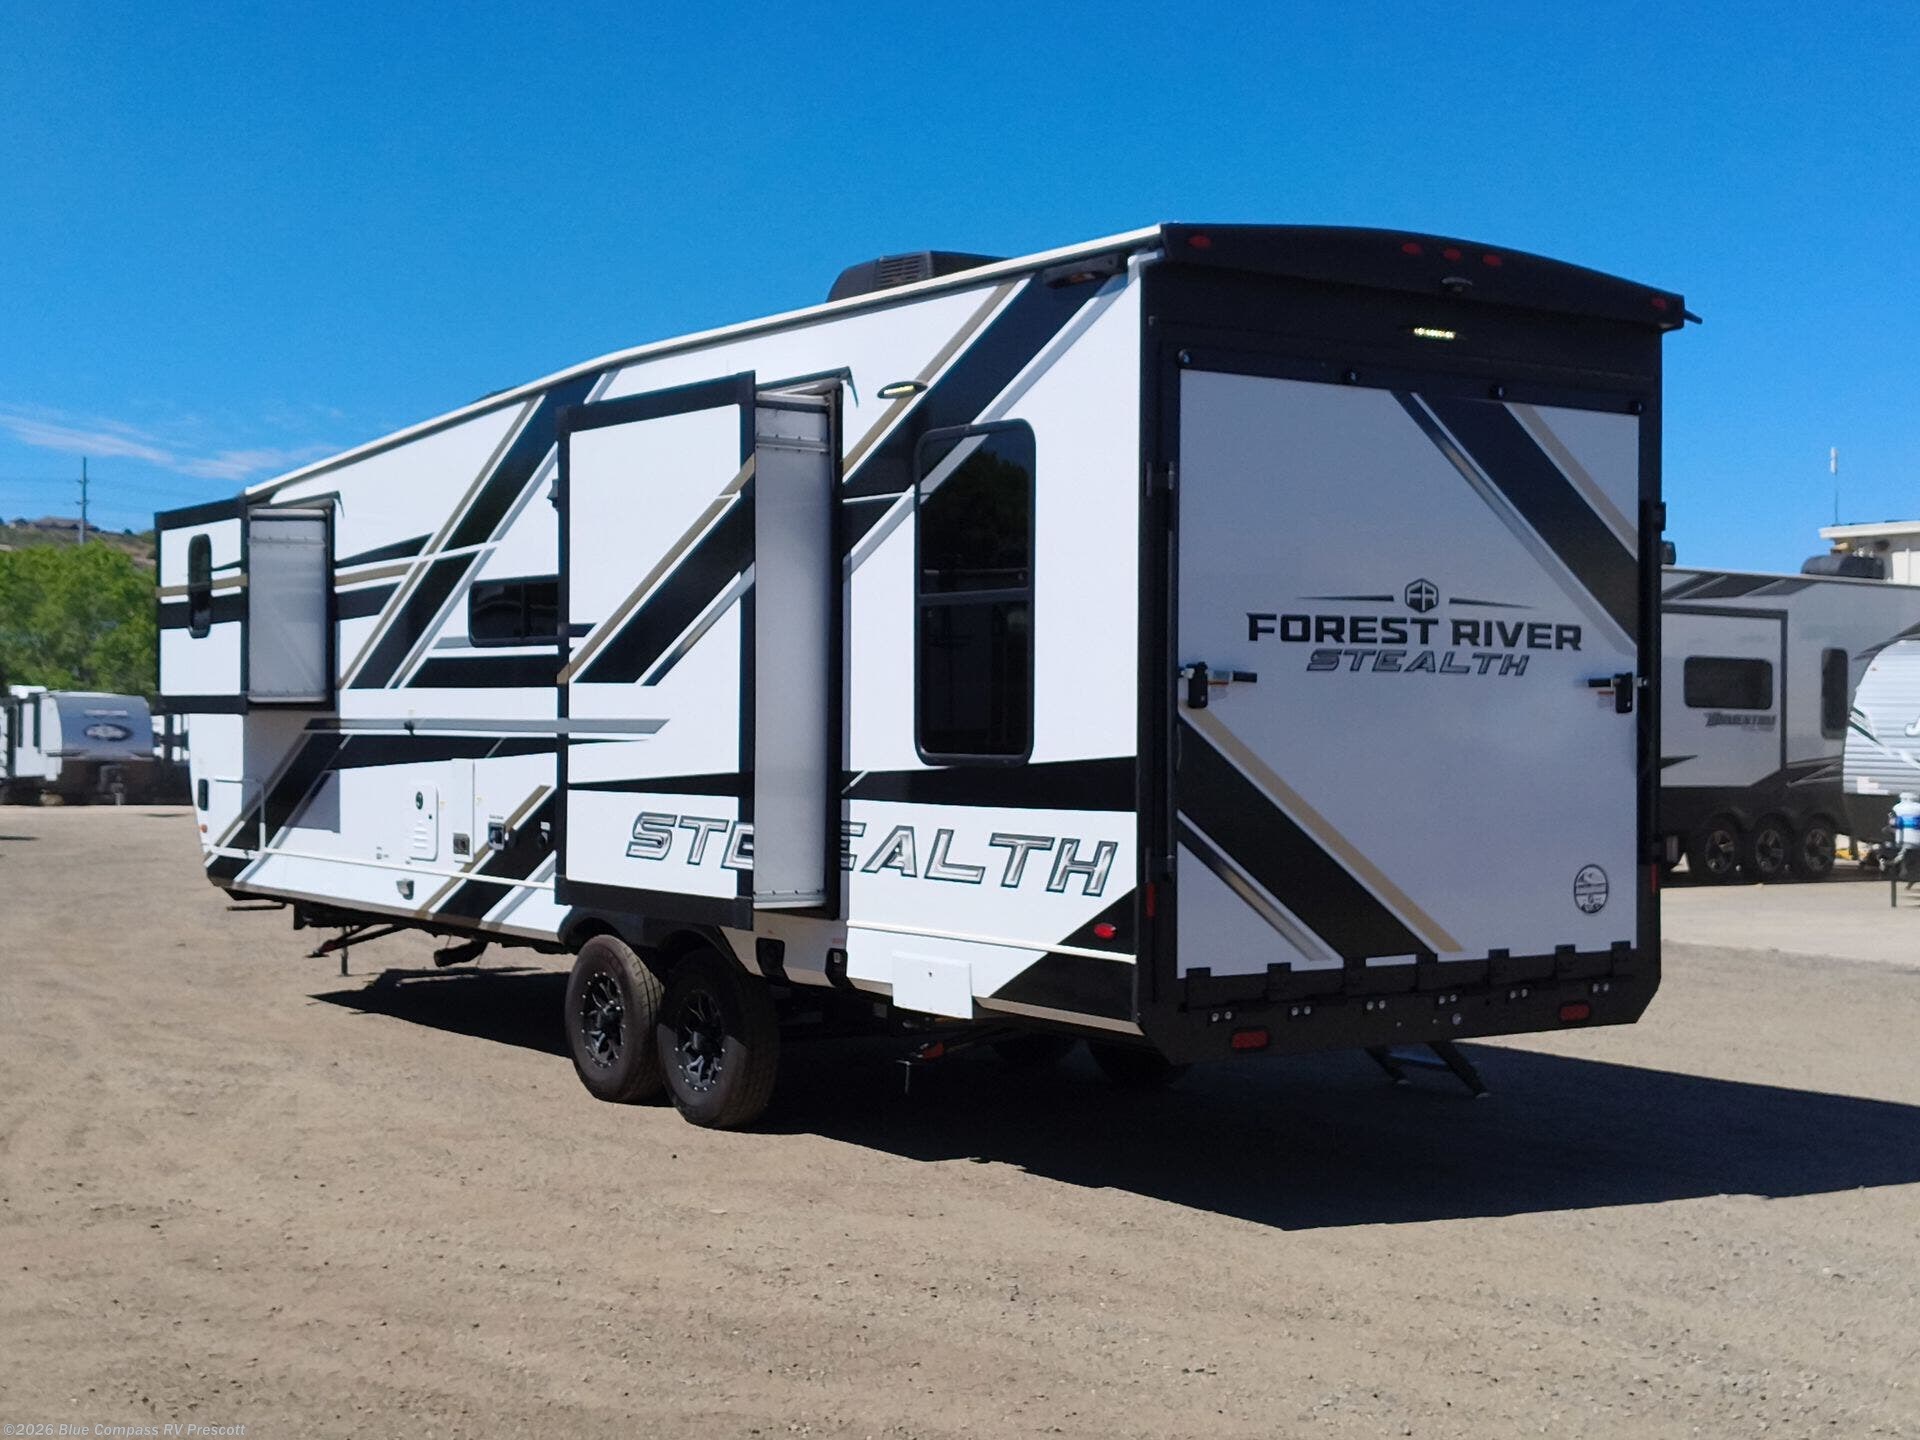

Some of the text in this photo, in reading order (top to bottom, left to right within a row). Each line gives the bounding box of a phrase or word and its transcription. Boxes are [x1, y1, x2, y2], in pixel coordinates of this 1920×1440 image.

[1246, 612, 1582, 652] FOREST RIVER
[1306, 648, 1530, 677] STEALTH
